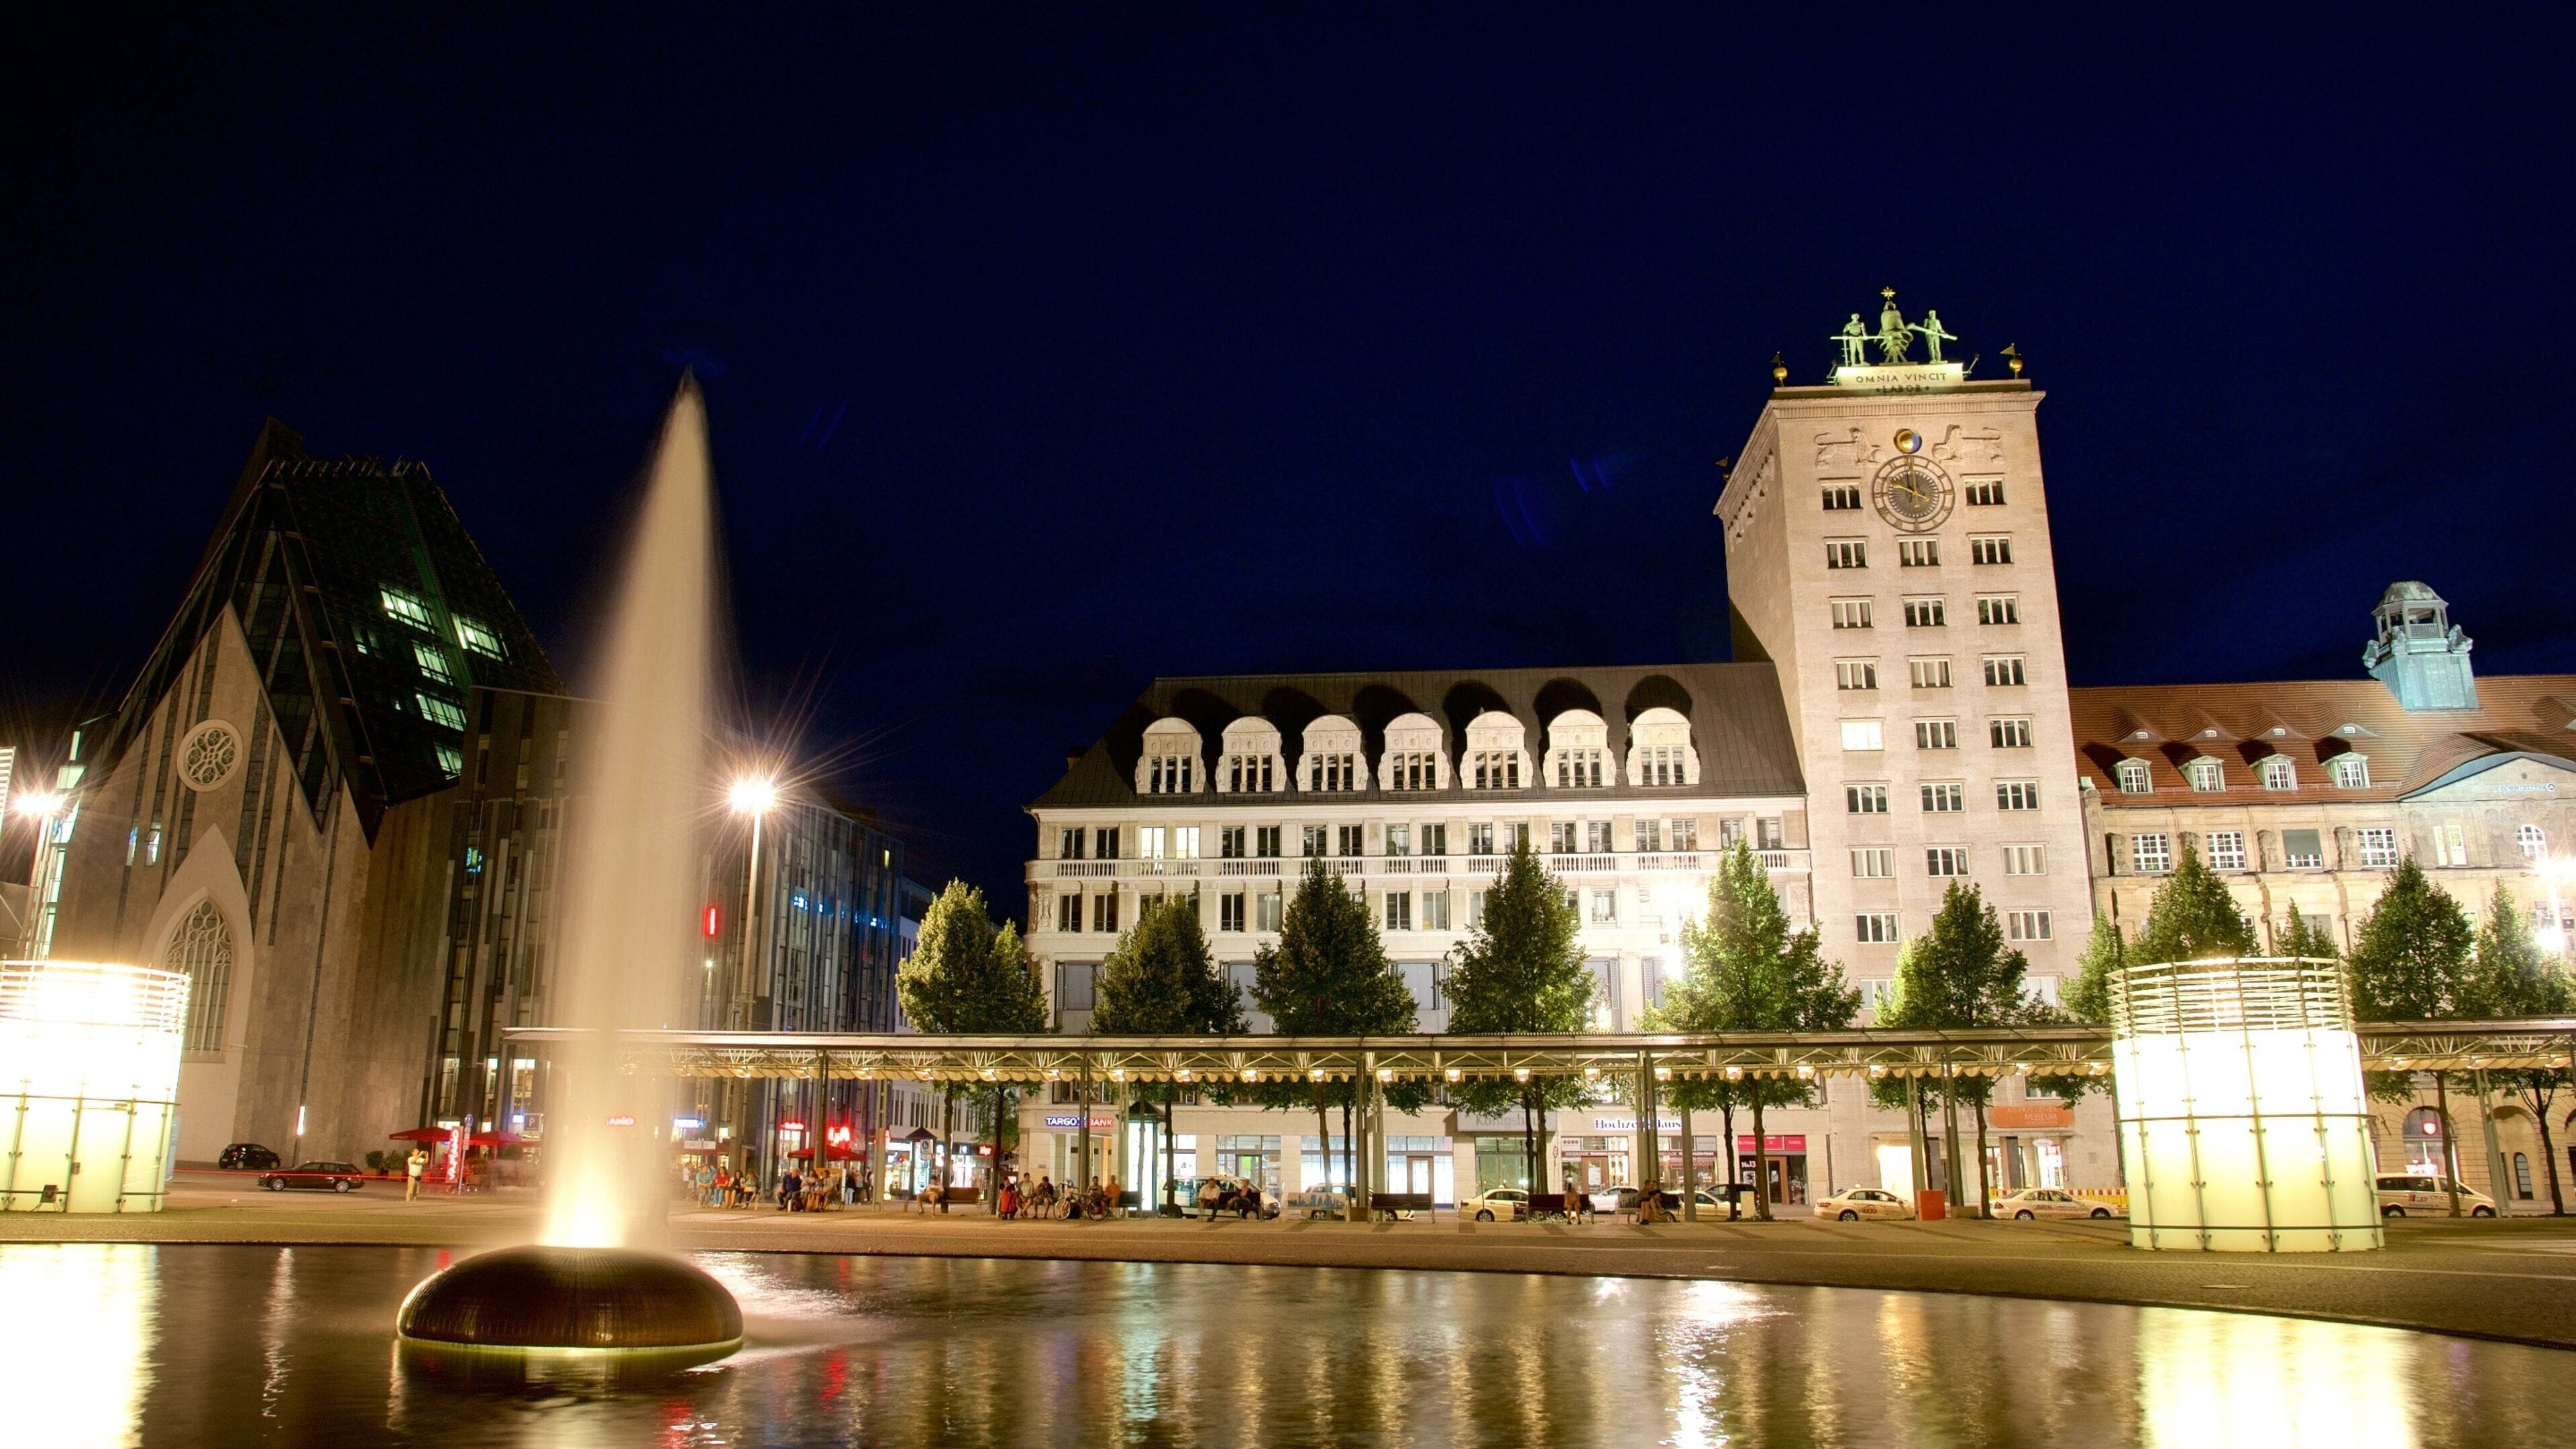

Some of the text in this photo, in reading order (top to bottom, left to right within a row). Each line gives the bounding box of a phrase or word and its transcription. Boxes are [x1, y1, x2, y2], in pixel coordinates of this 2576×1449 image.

[1856, 373, 1947, 383] OMNIA VINCIT
[1882, 384, 1922, 393] LABOR
[1046, 1117, 1077, 1126] TARGO
[2024, 1113, 2057, 1121] MUSEUM
[447, 1129, 460, 1181] VAPIANO
